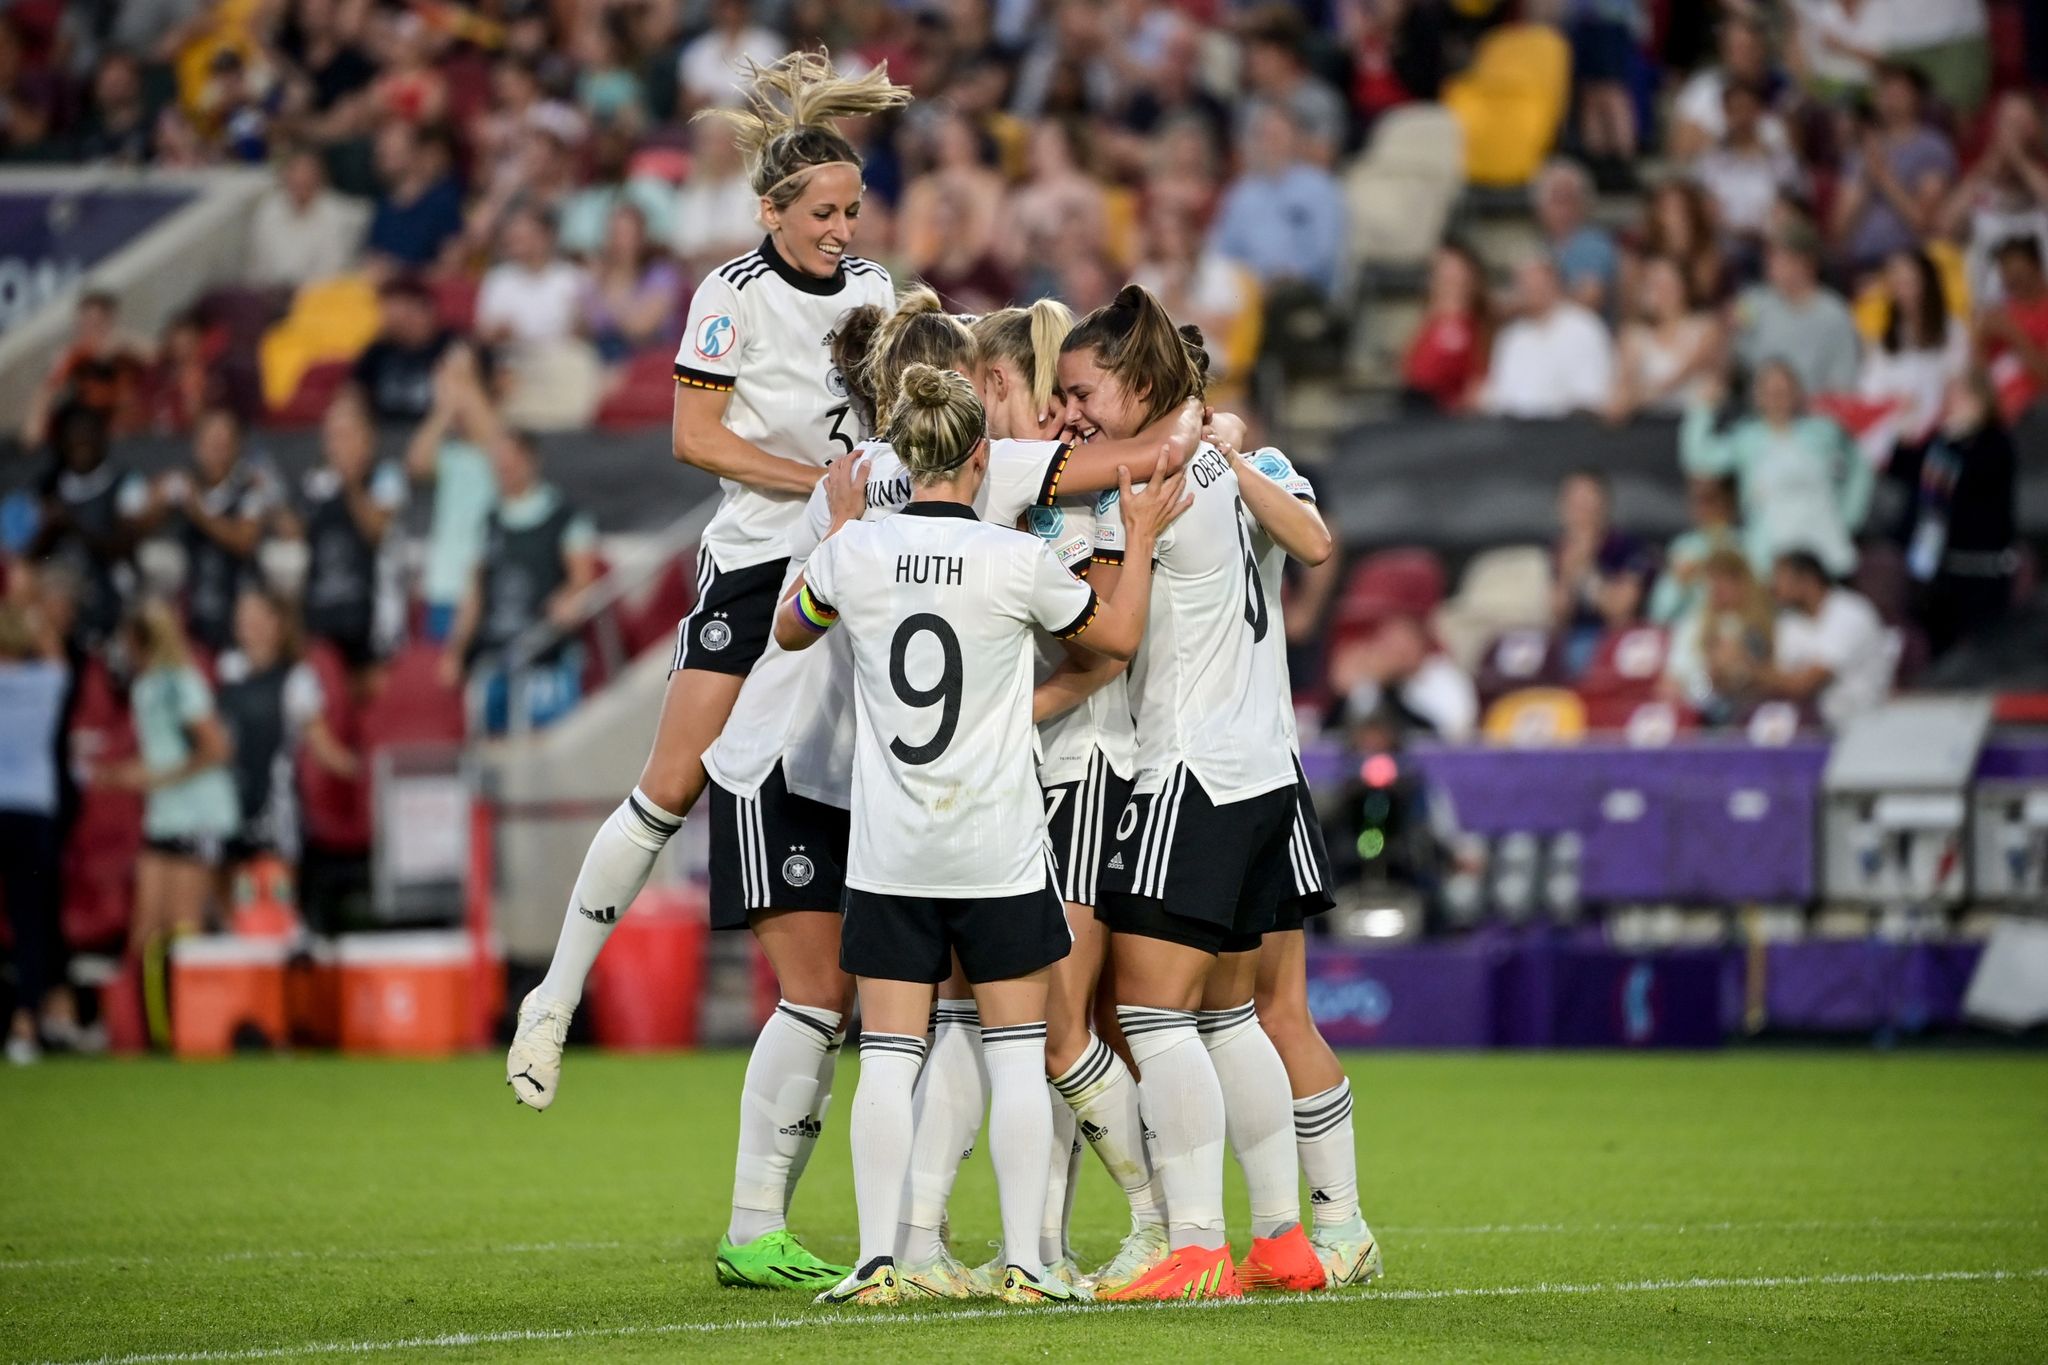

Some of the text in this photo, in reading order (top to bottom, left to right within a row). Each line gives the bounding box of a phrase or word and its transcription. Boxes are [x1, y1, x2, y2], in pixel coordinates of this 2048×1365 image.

[896, 555, 963, 585] HUTH
[1234, 495, 1268, 644] 6
[889, 613, 963, 765] 9
